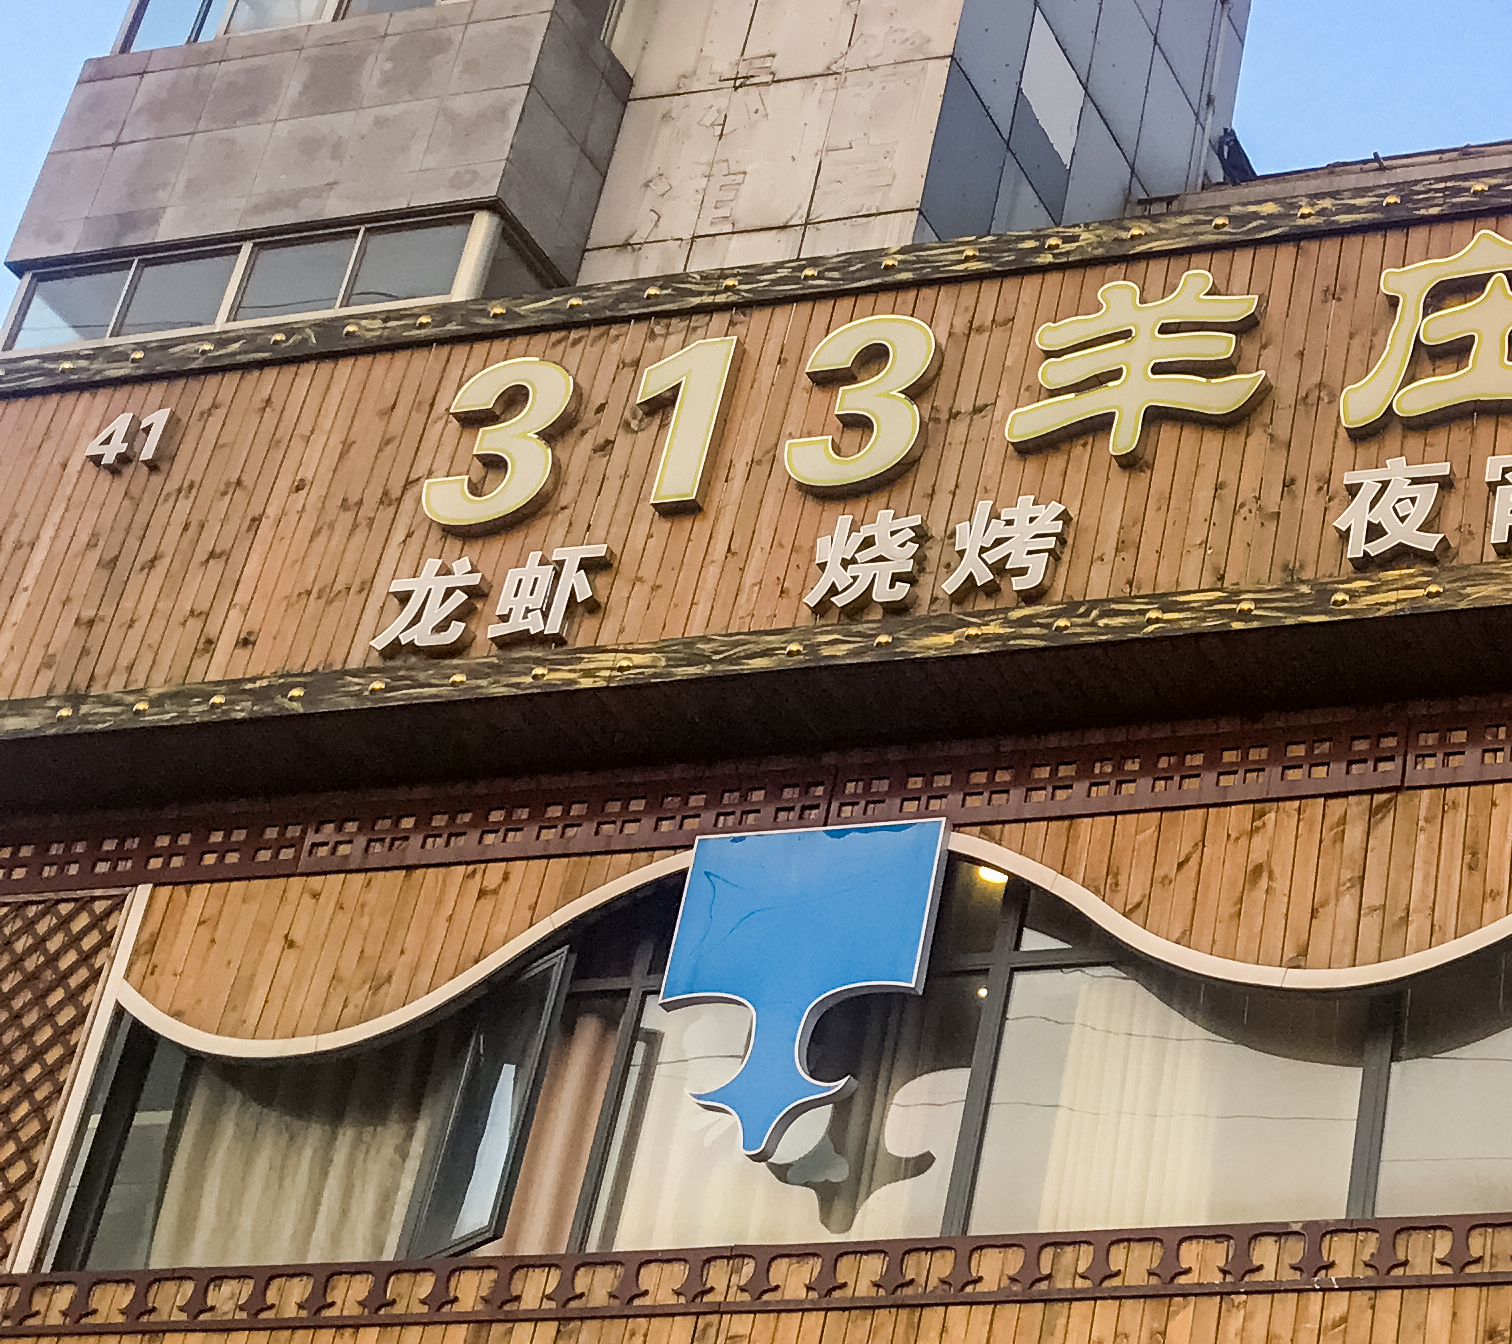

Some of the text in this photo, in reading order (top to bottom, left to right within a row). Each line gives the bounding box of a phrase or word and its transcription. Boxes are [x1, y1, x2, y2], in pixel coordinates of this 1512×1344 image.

[85, 408, 171, 465] 41
[370, 543, 608, 652] 龙虾
[803, 494, 1068, 610] 烧烤
